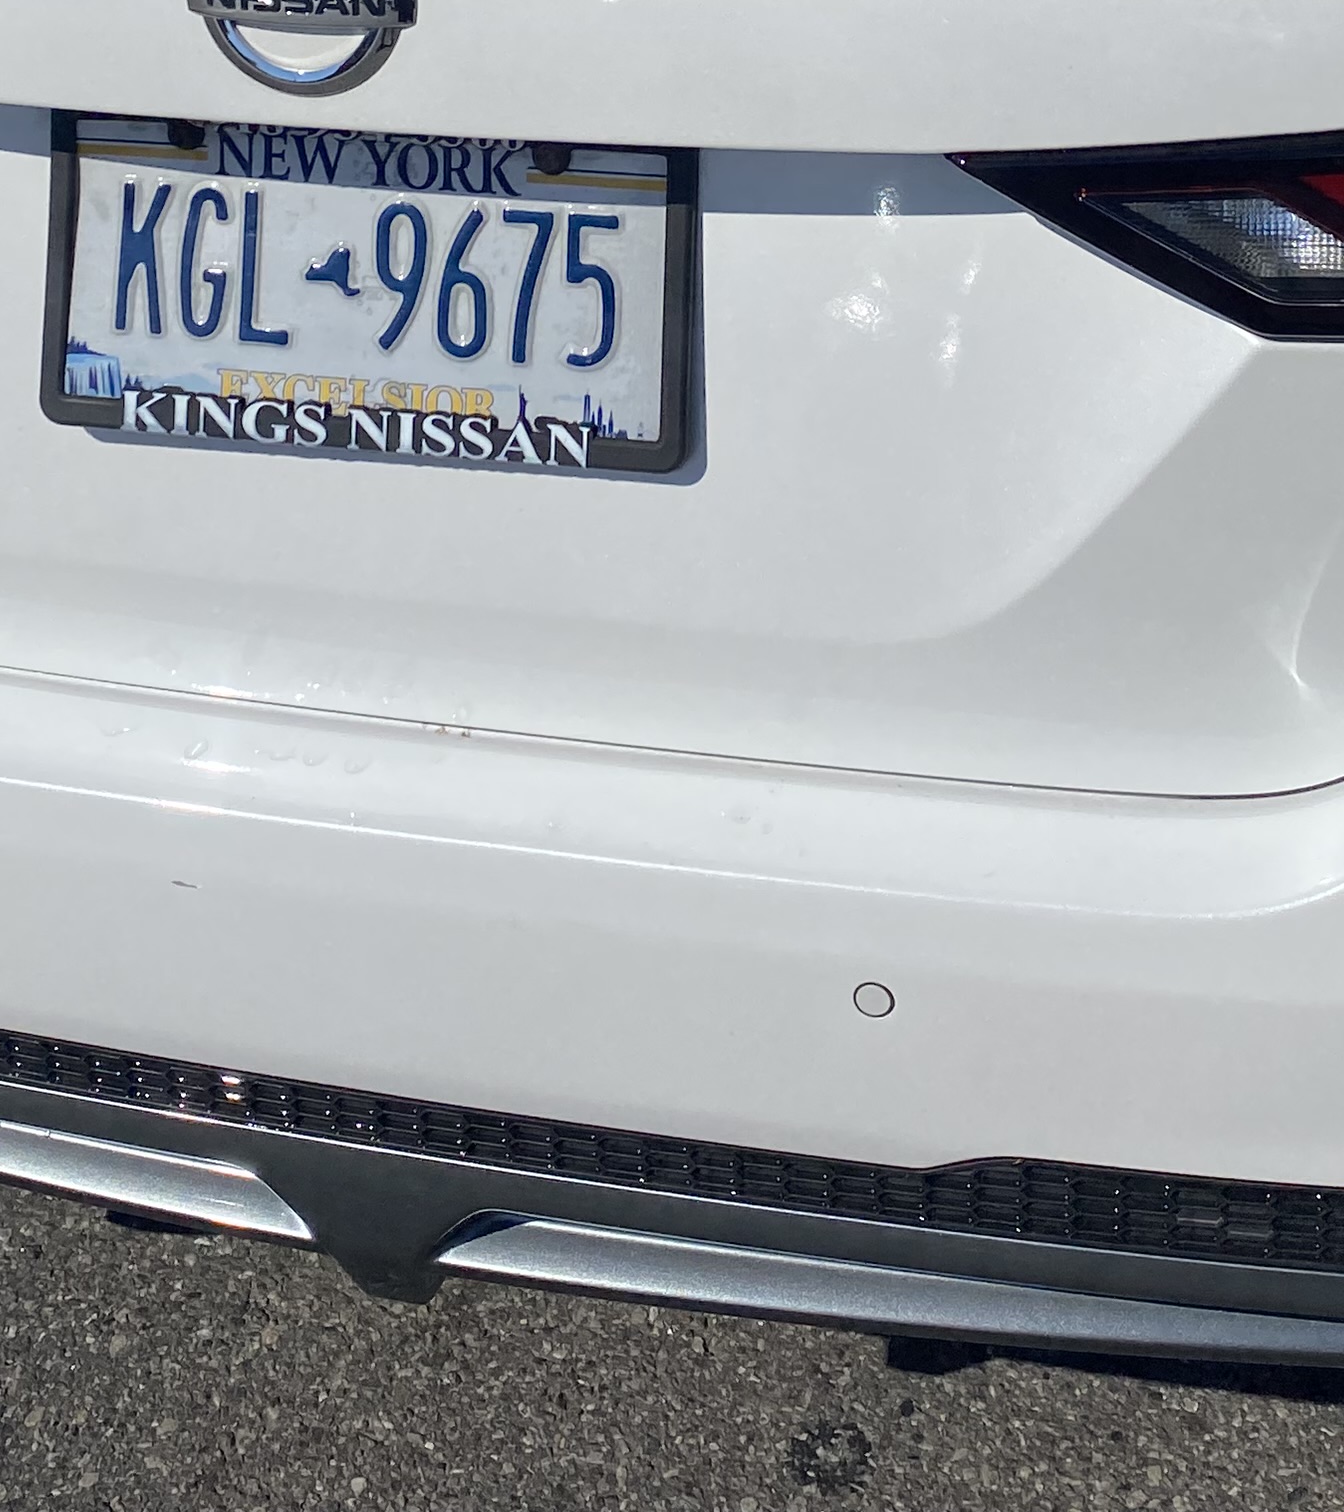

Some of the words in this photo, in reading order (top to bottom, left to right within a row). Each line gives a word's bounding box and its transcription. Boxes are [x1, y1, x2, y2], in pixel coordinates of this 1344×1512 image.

[216, 131, 357, 183] NEW
[369, 144, 522, 197] YORK
[115, 178, 289, 346] KGL
[375, 198, 621, 368] 9675
[121, 390, 328, 448] KINGS
[348, 406, 592, 468] NISSAN
